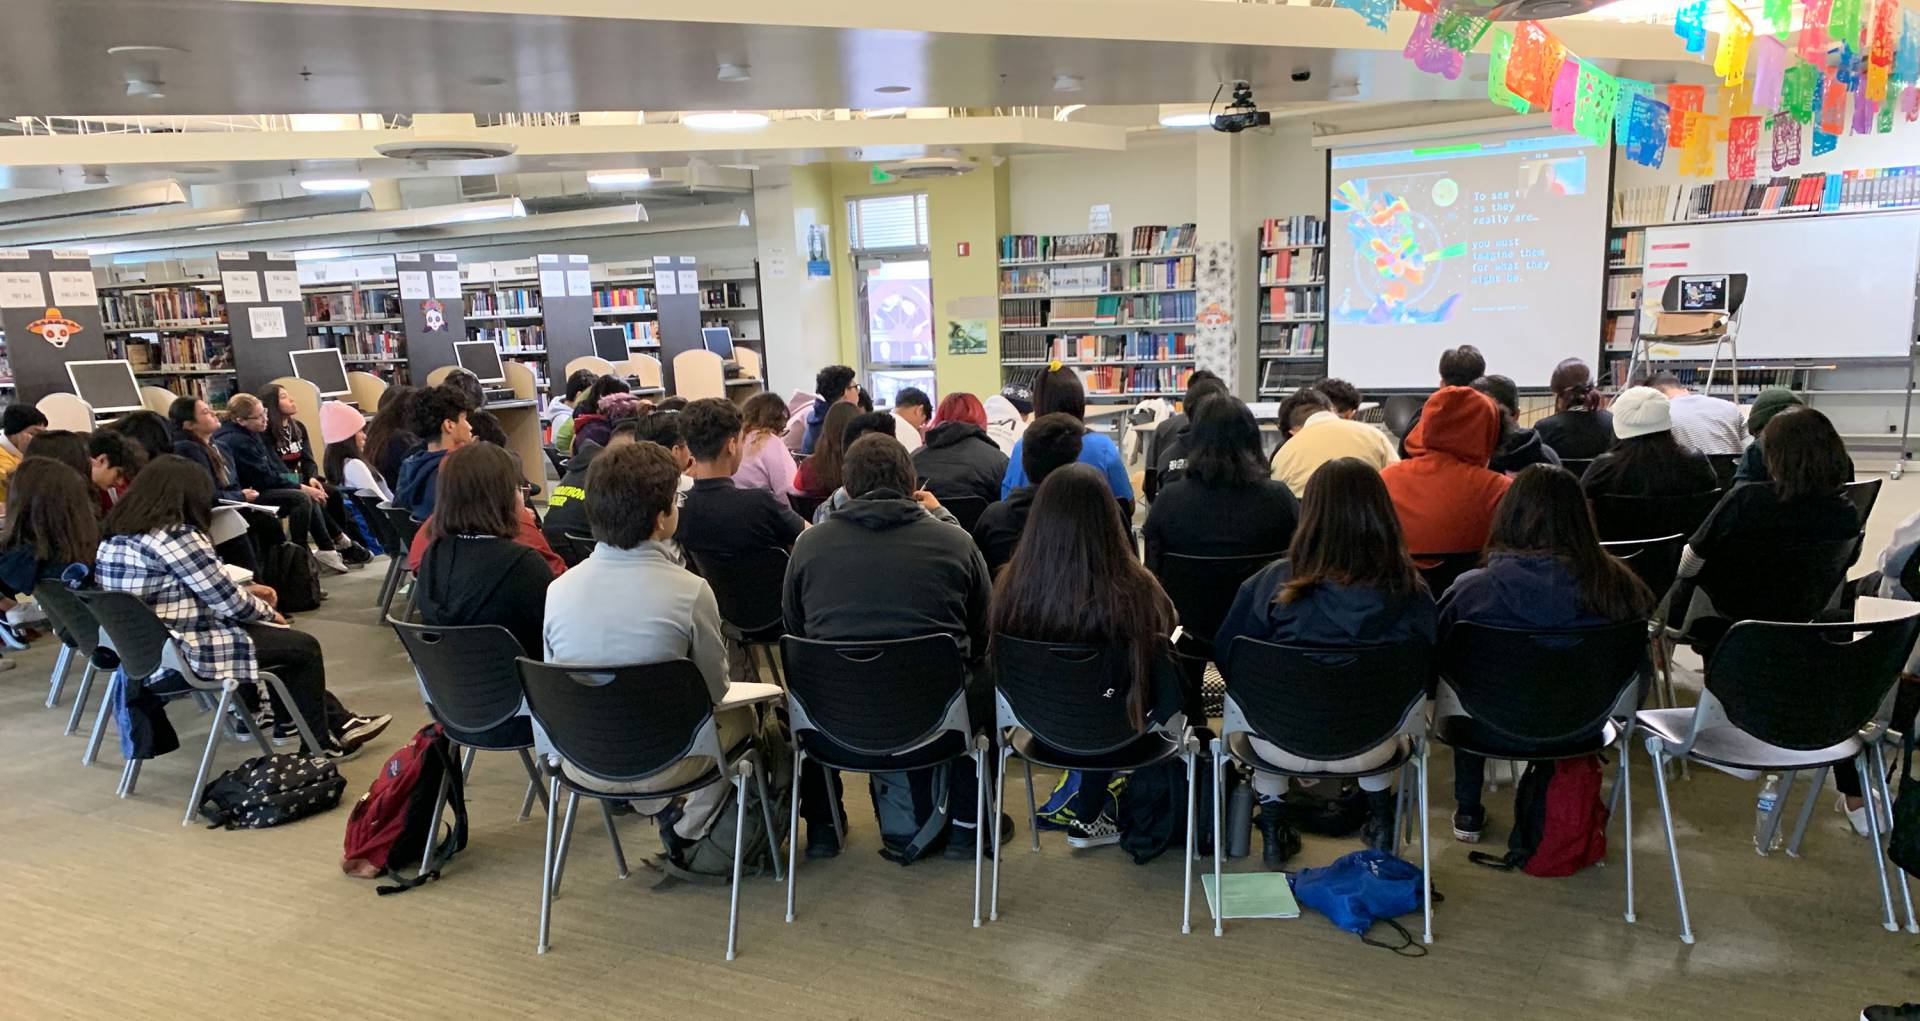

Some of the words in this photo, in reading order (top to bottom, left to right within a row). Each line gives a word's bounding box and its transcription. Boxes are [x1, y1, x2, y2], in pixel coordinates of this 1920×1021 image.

[1473, 192, 1486, 201] To
[1492, 203, 1515, 213] they
[1473, 214, 1509, 225] really
[1472, 240, 1490, 249] you
[1472, 263, 1489, 273] for
[1526, 260, 1550, 271] they
